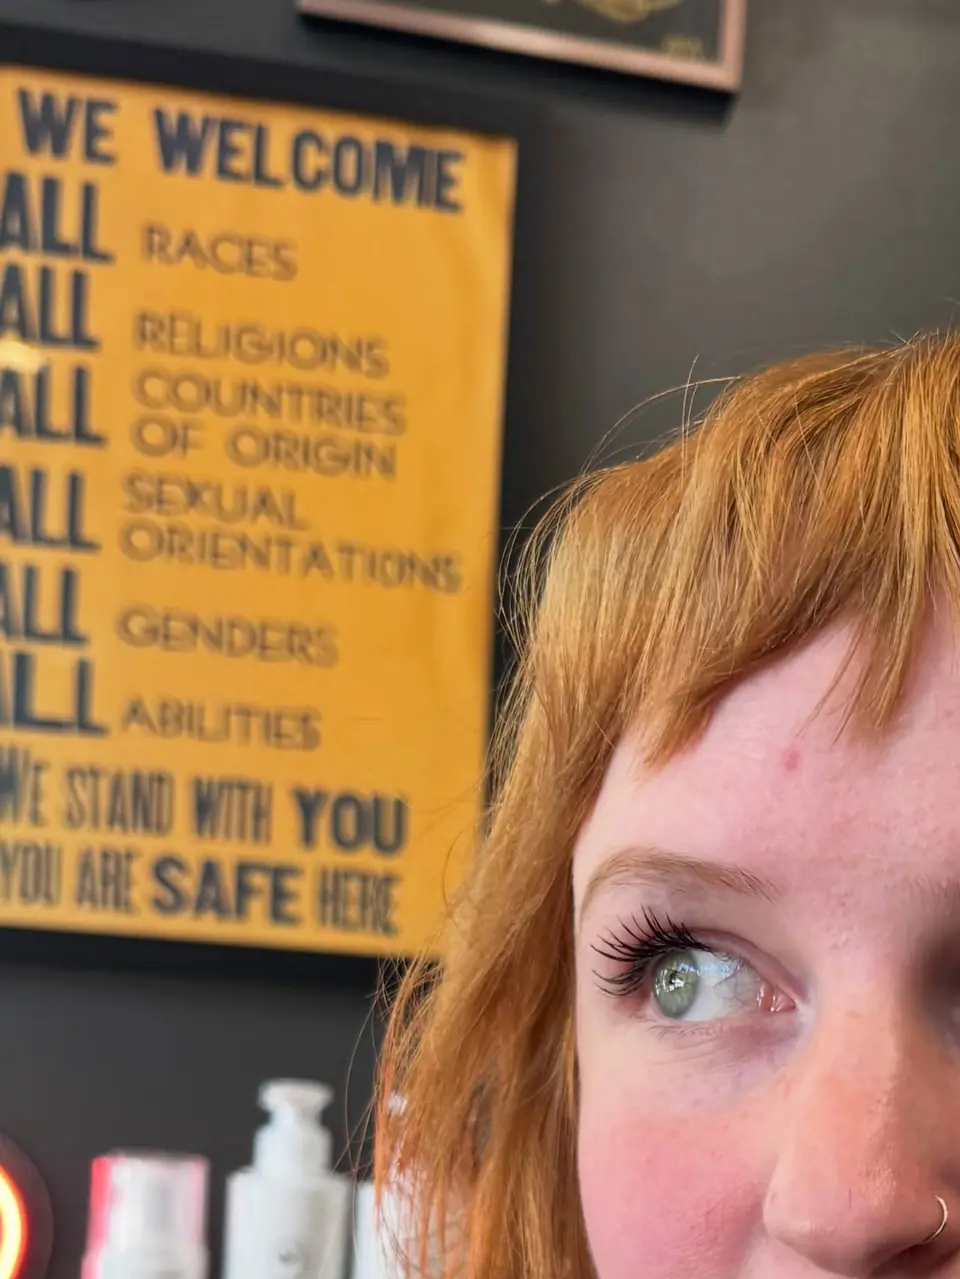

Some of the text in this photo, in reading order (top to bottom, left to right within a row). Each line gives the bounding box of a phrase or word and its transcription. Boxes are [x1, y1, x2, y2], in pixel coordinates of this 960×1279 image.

[19, 87, 465, 212] WE WELCOME
[0, 171, 298, 281] ALL RACES
[0, 263, 390, 378] ALL RELIGIONS
[133, 417, 398, 479] OF ORIGIN
[134, 369, 407, 435] COUNTRIES
[121, 472, 306, 530] SEXUAL
[119, 521, 462, 595] ORIENTATIONS
[116, 604, 340, 668] GENDERS
[0, 651, 322, 752] LL ABILITIES
[65, 765, 174, 836] STAND
[192, 775, 273, 846] WITH
[293, 783, 410, 857] YOU
[0, 838, 402, 936] YOU ARE SAFE HERE
